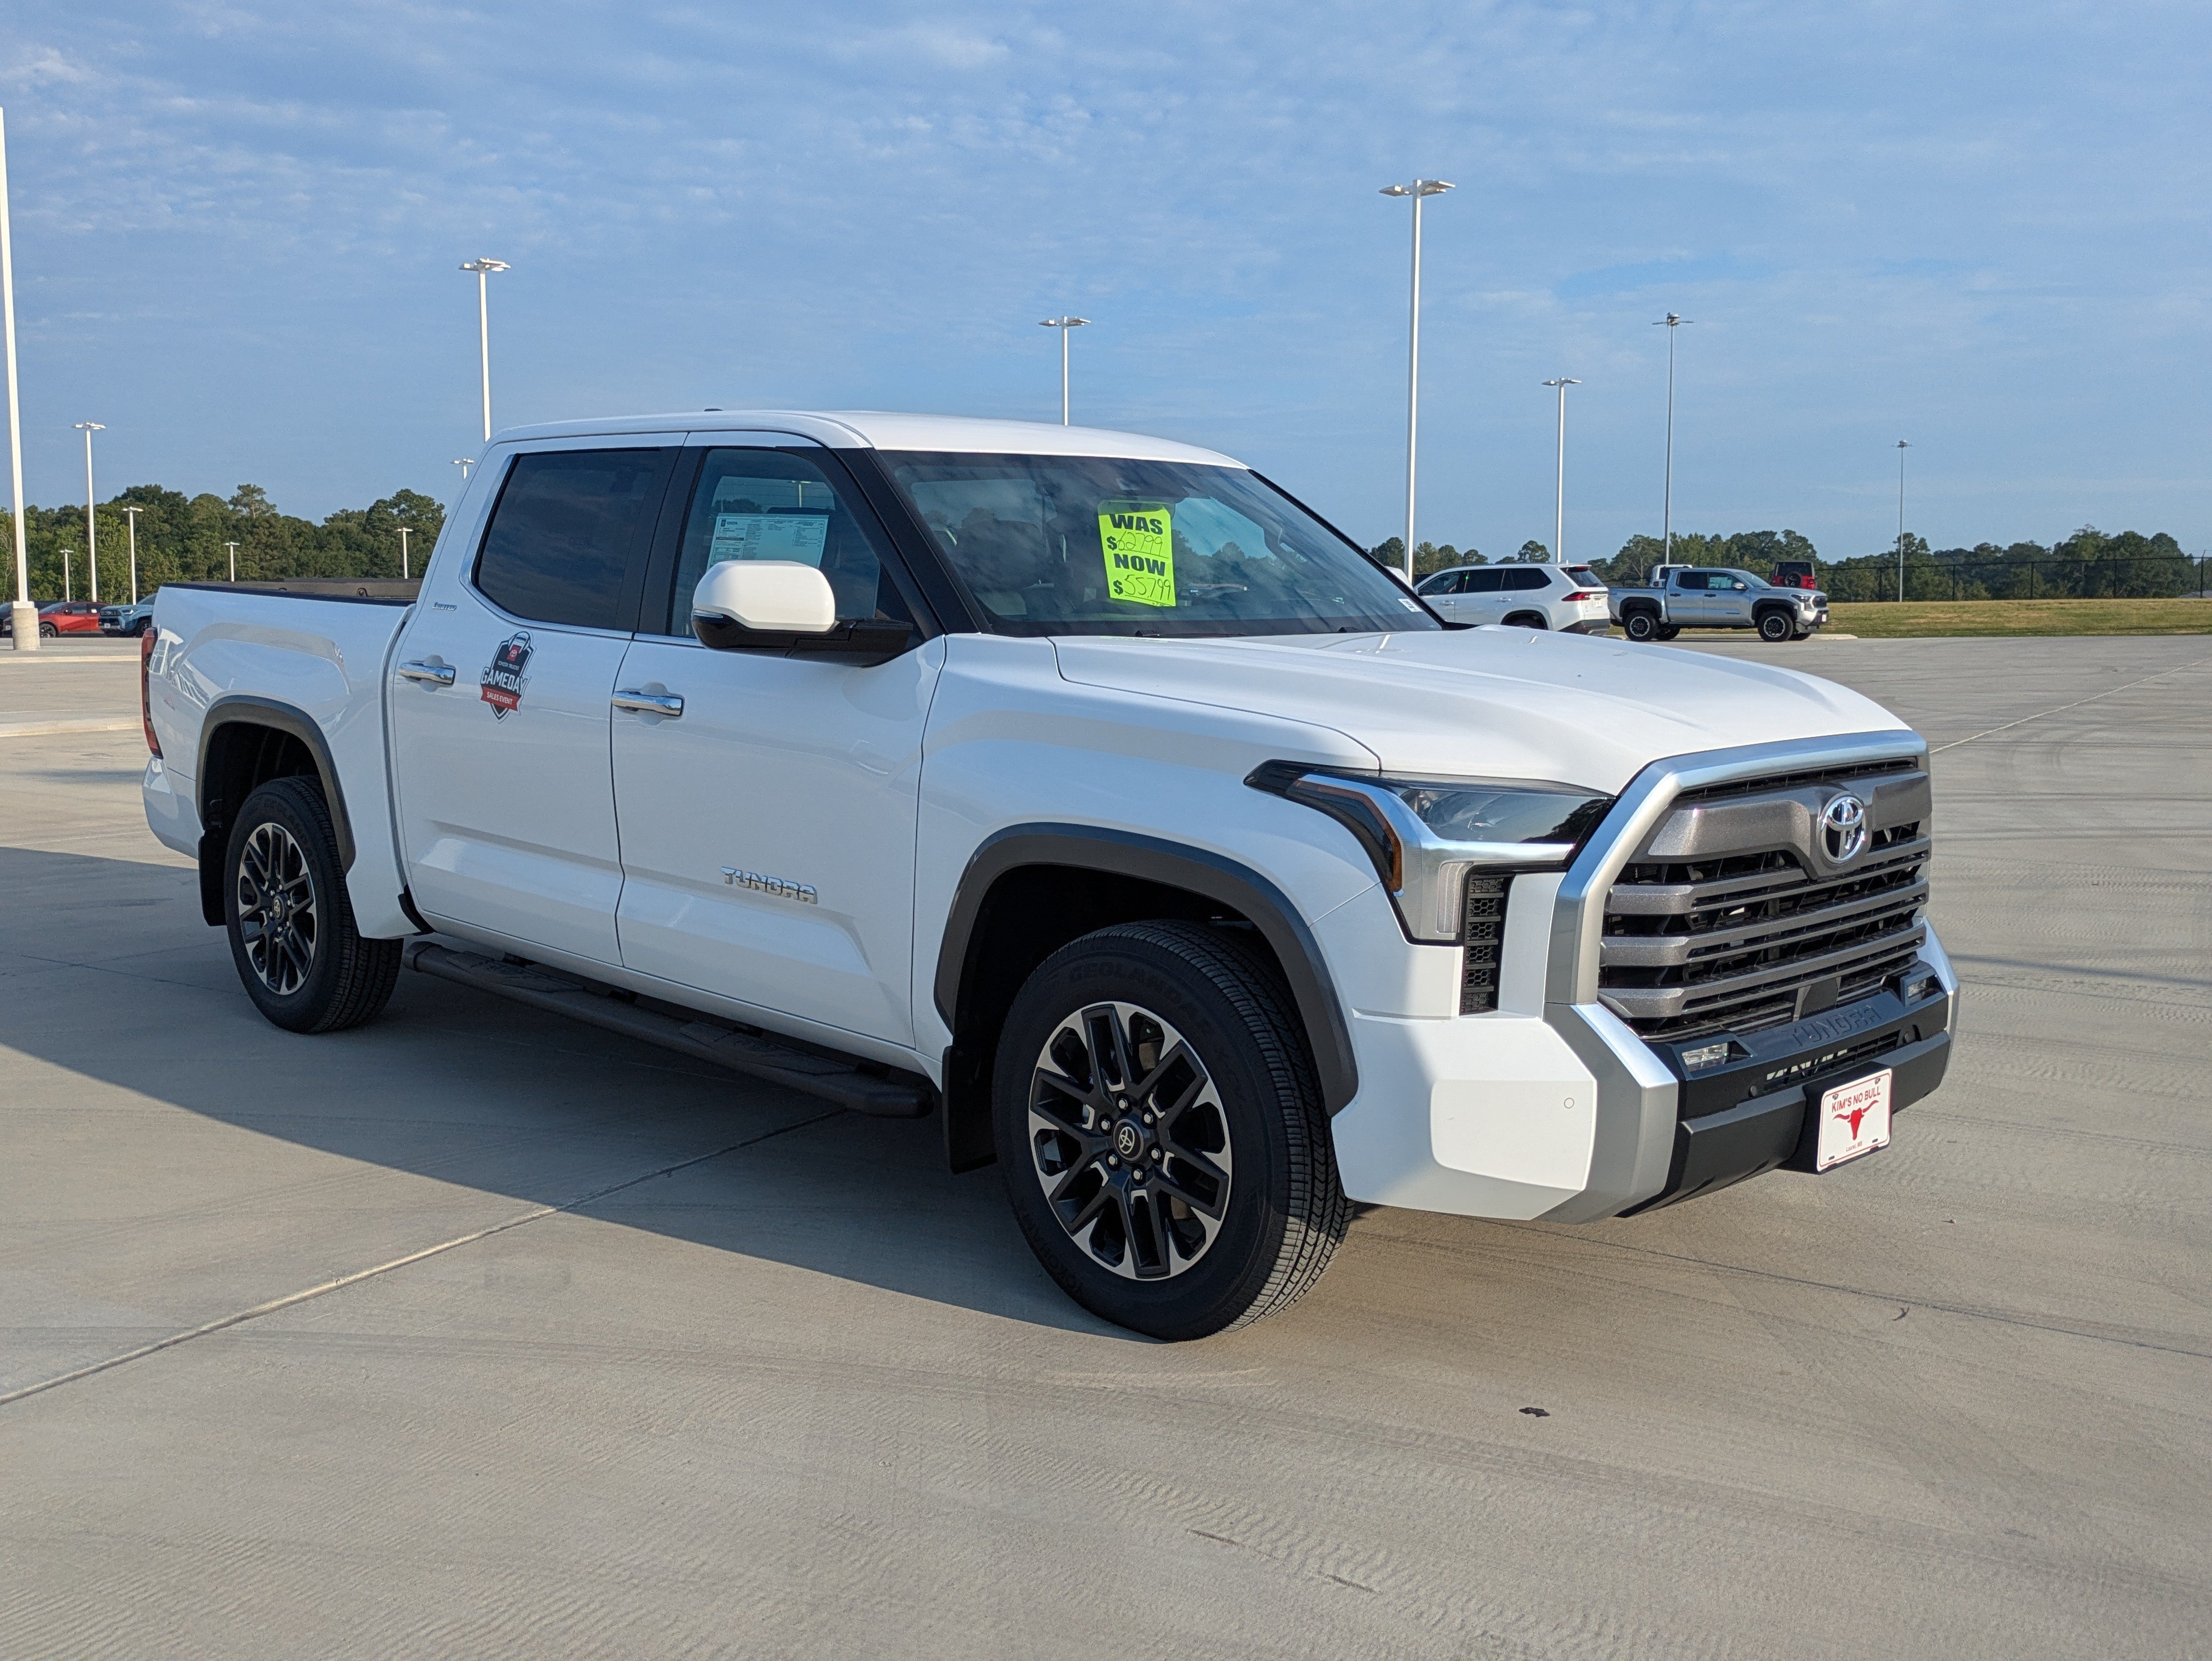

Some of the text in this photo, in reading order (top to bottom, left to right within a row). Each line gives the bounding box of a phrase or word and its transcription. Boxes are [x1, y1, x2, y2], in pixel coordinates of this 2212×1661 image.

[1109, 513, 1163, 535] WAS
[1113, 553, 1166, 577] NOW
[481, 668, 528, 695] GAMEDAY
[487, 691, 513, 705] SALES EVENT
[720, 866, 818, 904] TUNDRA
[1780, 1005, 1882, 1047] TUNDRA
[1832, 1086, 1880, 1113] KIM'S NO BULL
